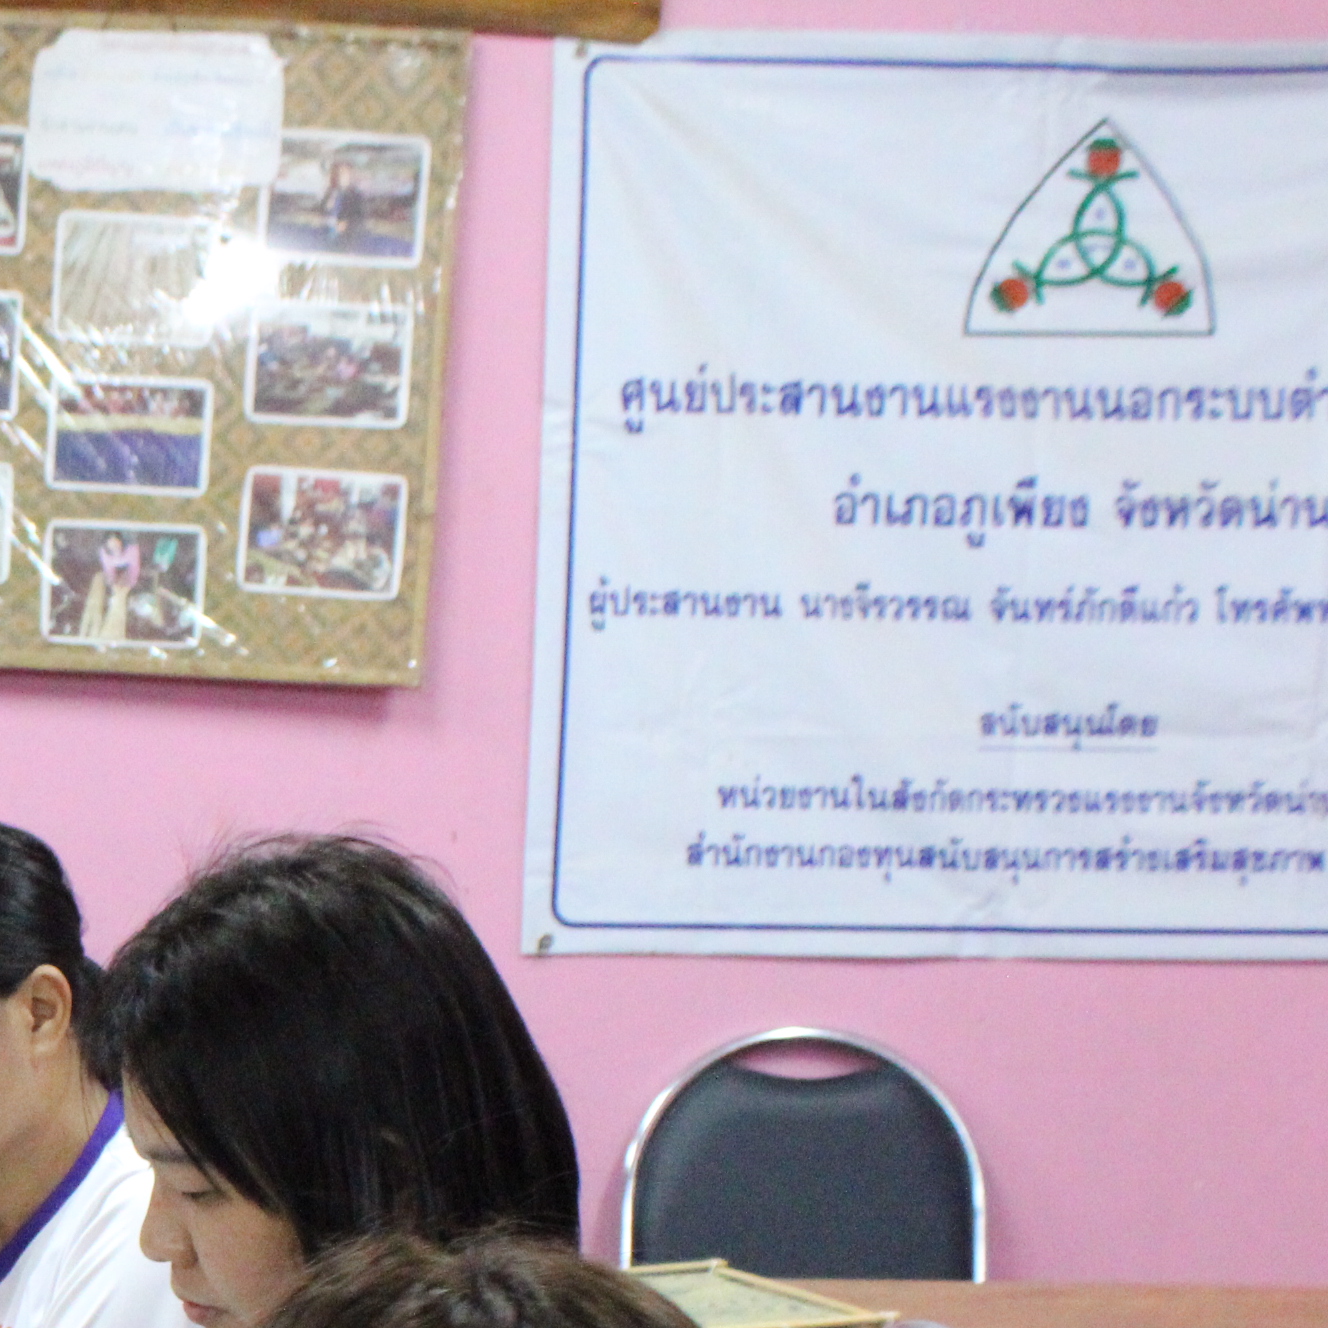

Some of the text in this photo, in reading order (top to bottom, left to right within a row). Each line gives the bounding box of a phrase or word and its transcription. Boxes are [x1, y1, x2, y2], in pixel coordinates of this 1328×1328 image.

[834, 472, 1328, 549] อำเภอภูเพียง จังหวัดน่าน
[589, 574, 783, 632] ผู้ประสานงาน
[980, 701, 1159, 751] สนับสนุนโดย
